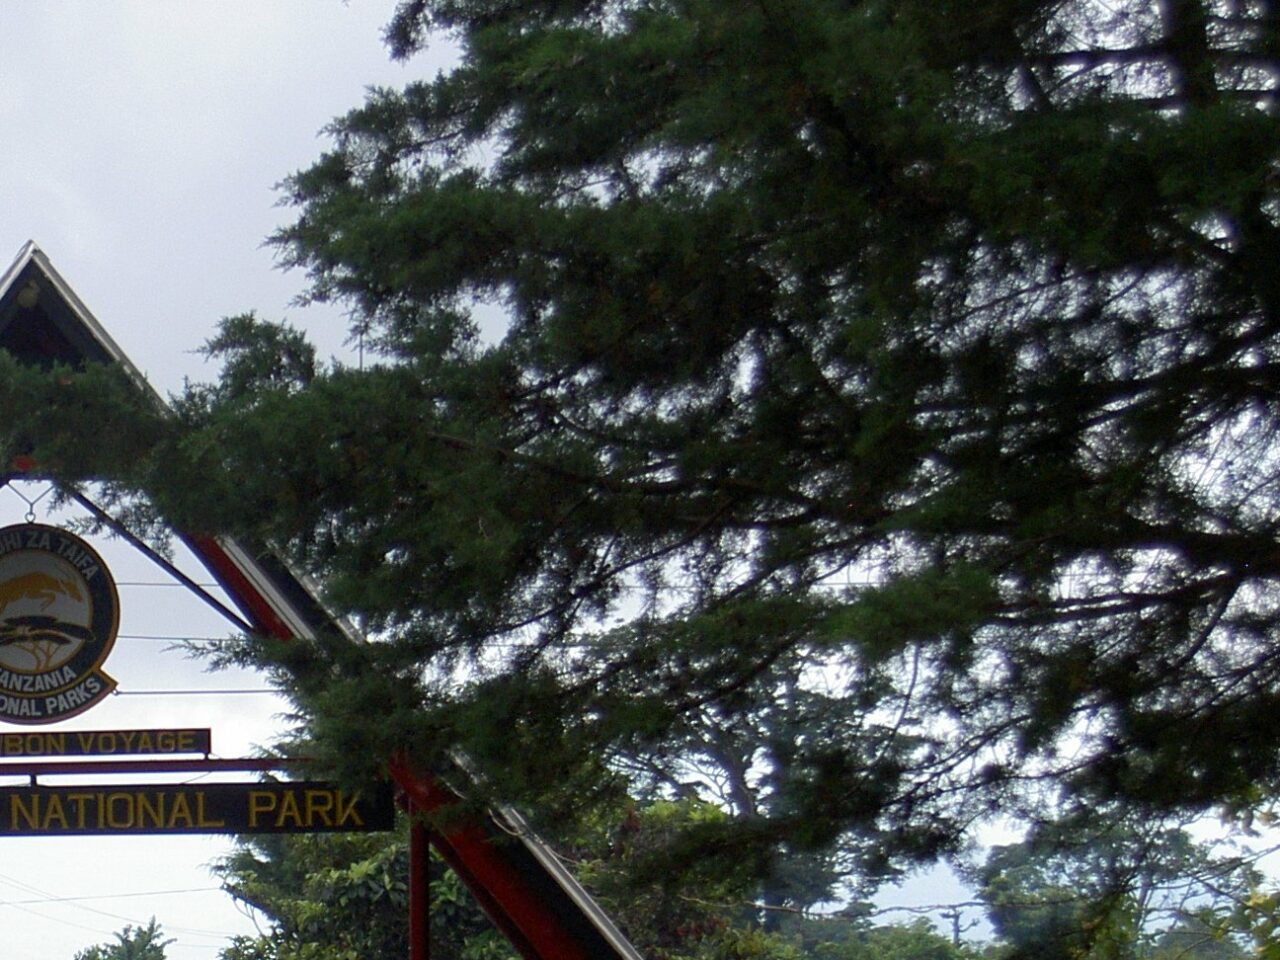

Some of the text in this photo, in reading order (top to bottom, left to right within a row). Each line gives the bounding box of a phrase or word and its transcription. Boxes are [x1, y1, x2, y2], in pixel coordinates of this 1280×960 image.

[27, 531, 50, 550] ZA
[57, 535, 100, 580] TAIFA
[46, 677, 100, 715] PARKS
[78, 731, 197, 753] VOYAGE
[10, 791, 225, 830] NATIONAL
[247, 789, 364, 828] PARK
